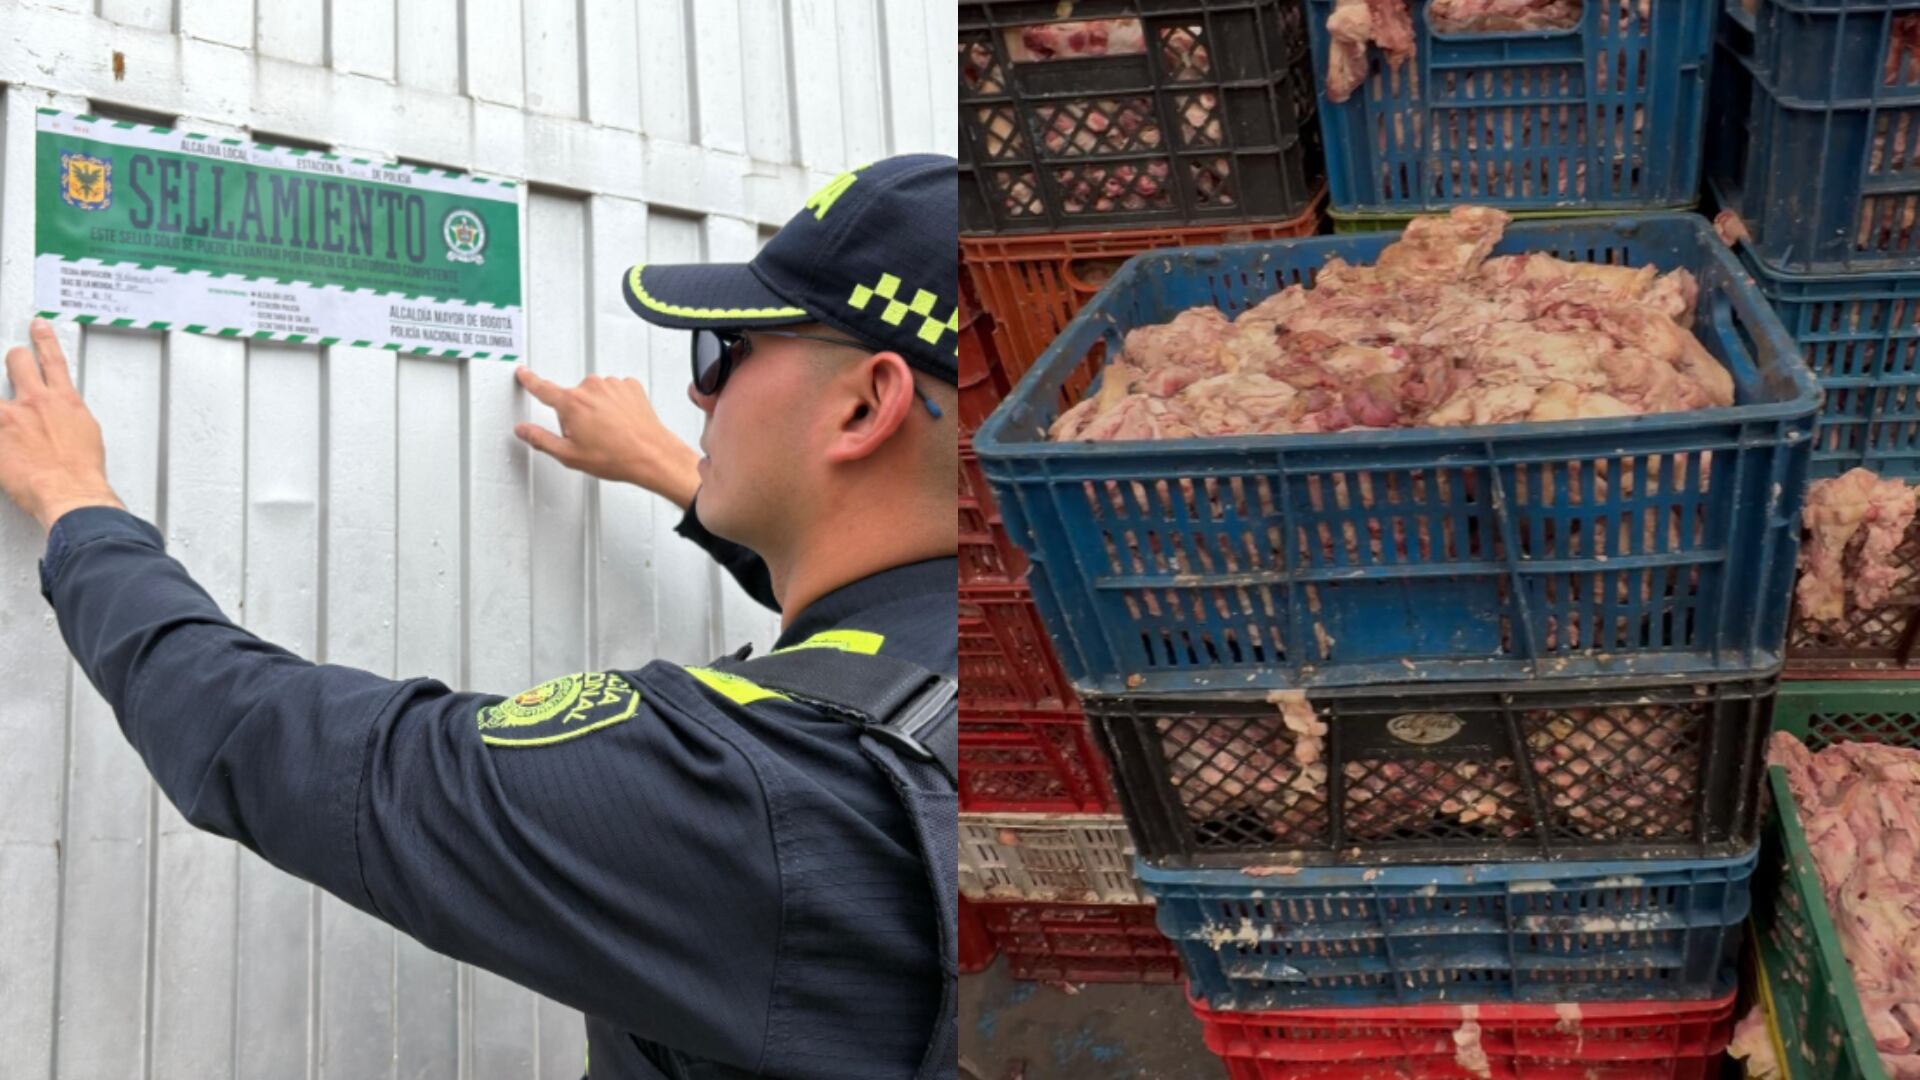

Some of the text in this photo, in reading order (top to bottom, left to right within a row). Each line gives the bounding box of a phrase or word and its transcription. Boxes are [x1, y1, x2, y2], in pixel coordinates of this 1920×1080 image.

[223, 146, 248, 161] LOCAL
[372, 168, 382, 180] DE
[129, 153, 427, 264] SELLAMIENTO
[90, 226, 115, 243] ESTE
[118, 229, 151, 246] SELLO
[182, 236, 193, 250] SE
[197, 238, 228, 255] PUEDE
[229, 242, 281, 261] LEVANTAR
[282, 249, 301, 264] POR
[338, 256, 350, 269] DE
[351, 257, 400, 275] AUTORIDAD
[403, 263, 460, 284] COMPETENTE
[389, 304, 432, 322] ALCALDÍA
[434, 309, 465, 325] MAYOR
[467, 313, 478, 327] DE
[423, 327, 460, 344] NACIONAL
[463, 332, 473, 344] DE
[475, 333, 514, 348] COLOMBIA
